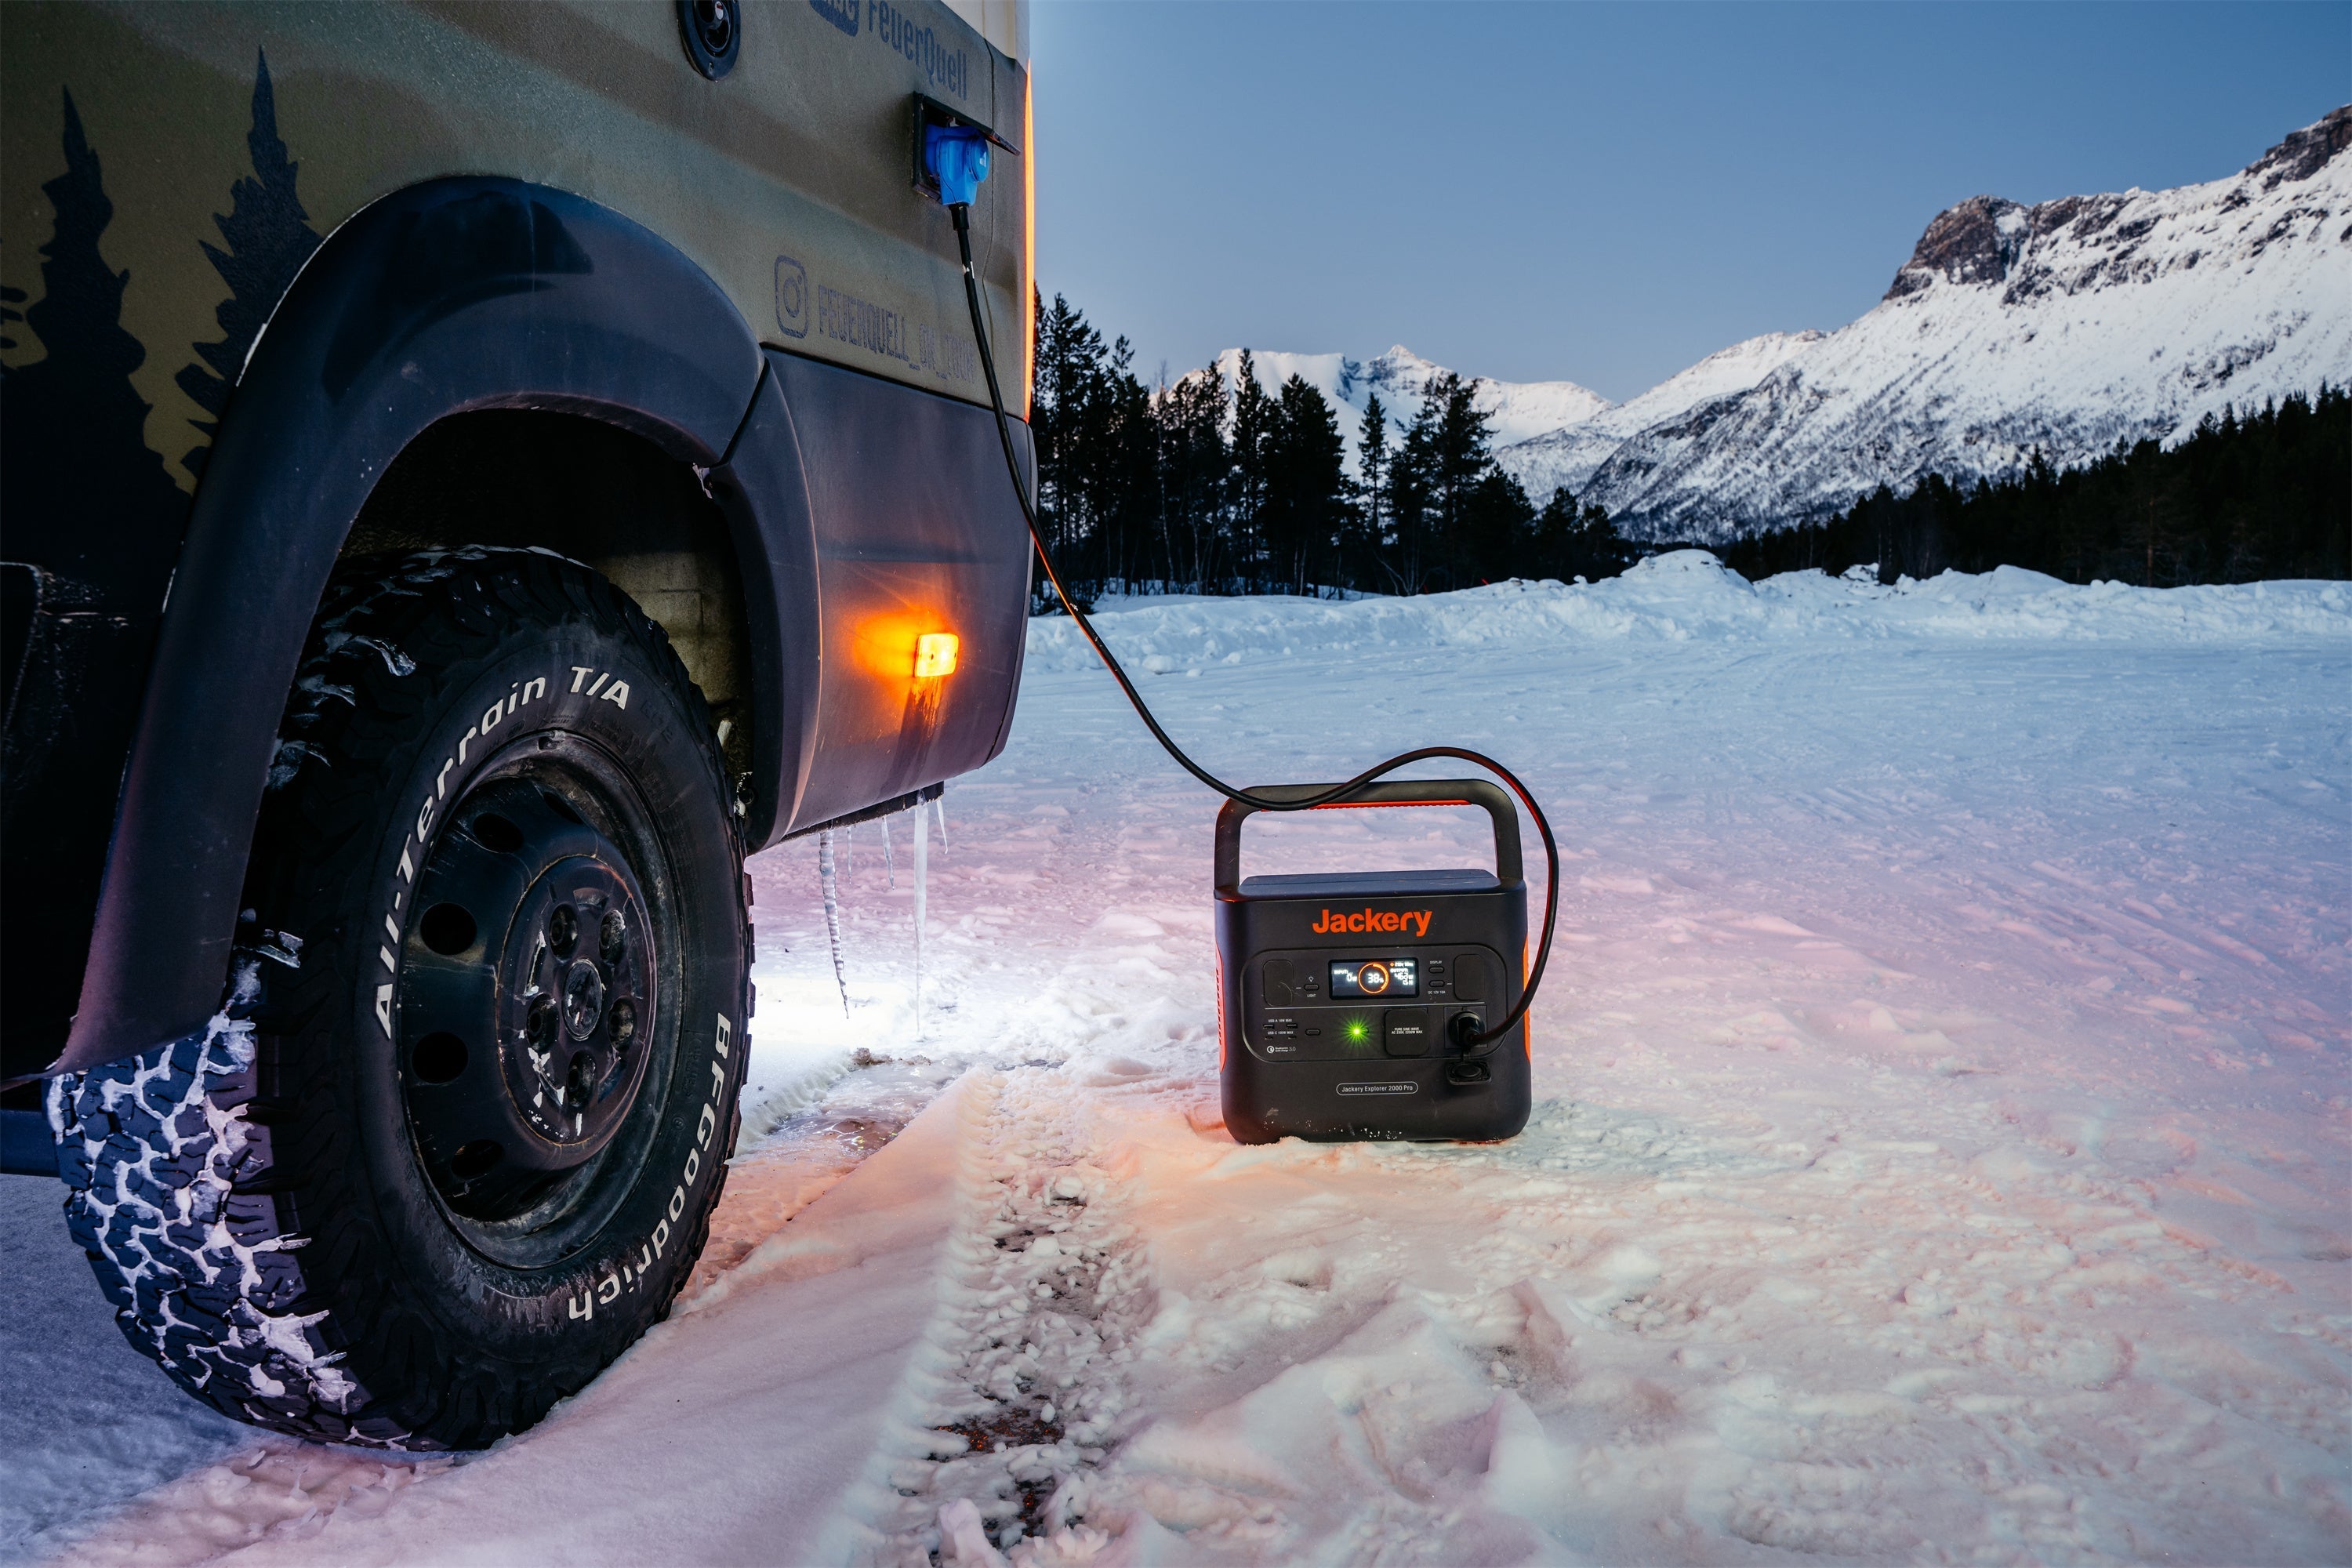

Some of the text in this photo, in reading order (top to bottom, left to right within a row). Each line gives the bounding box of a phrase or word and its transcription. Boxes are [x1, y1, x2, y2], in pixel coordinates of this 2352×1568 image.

[375, 675, 546, 1040] All-Terrain
[568, 666, 630, 710] T/A
[1312, 908, 1433, 938] Jackery
[568, 1012, 731, 1322] BFGoodrich
